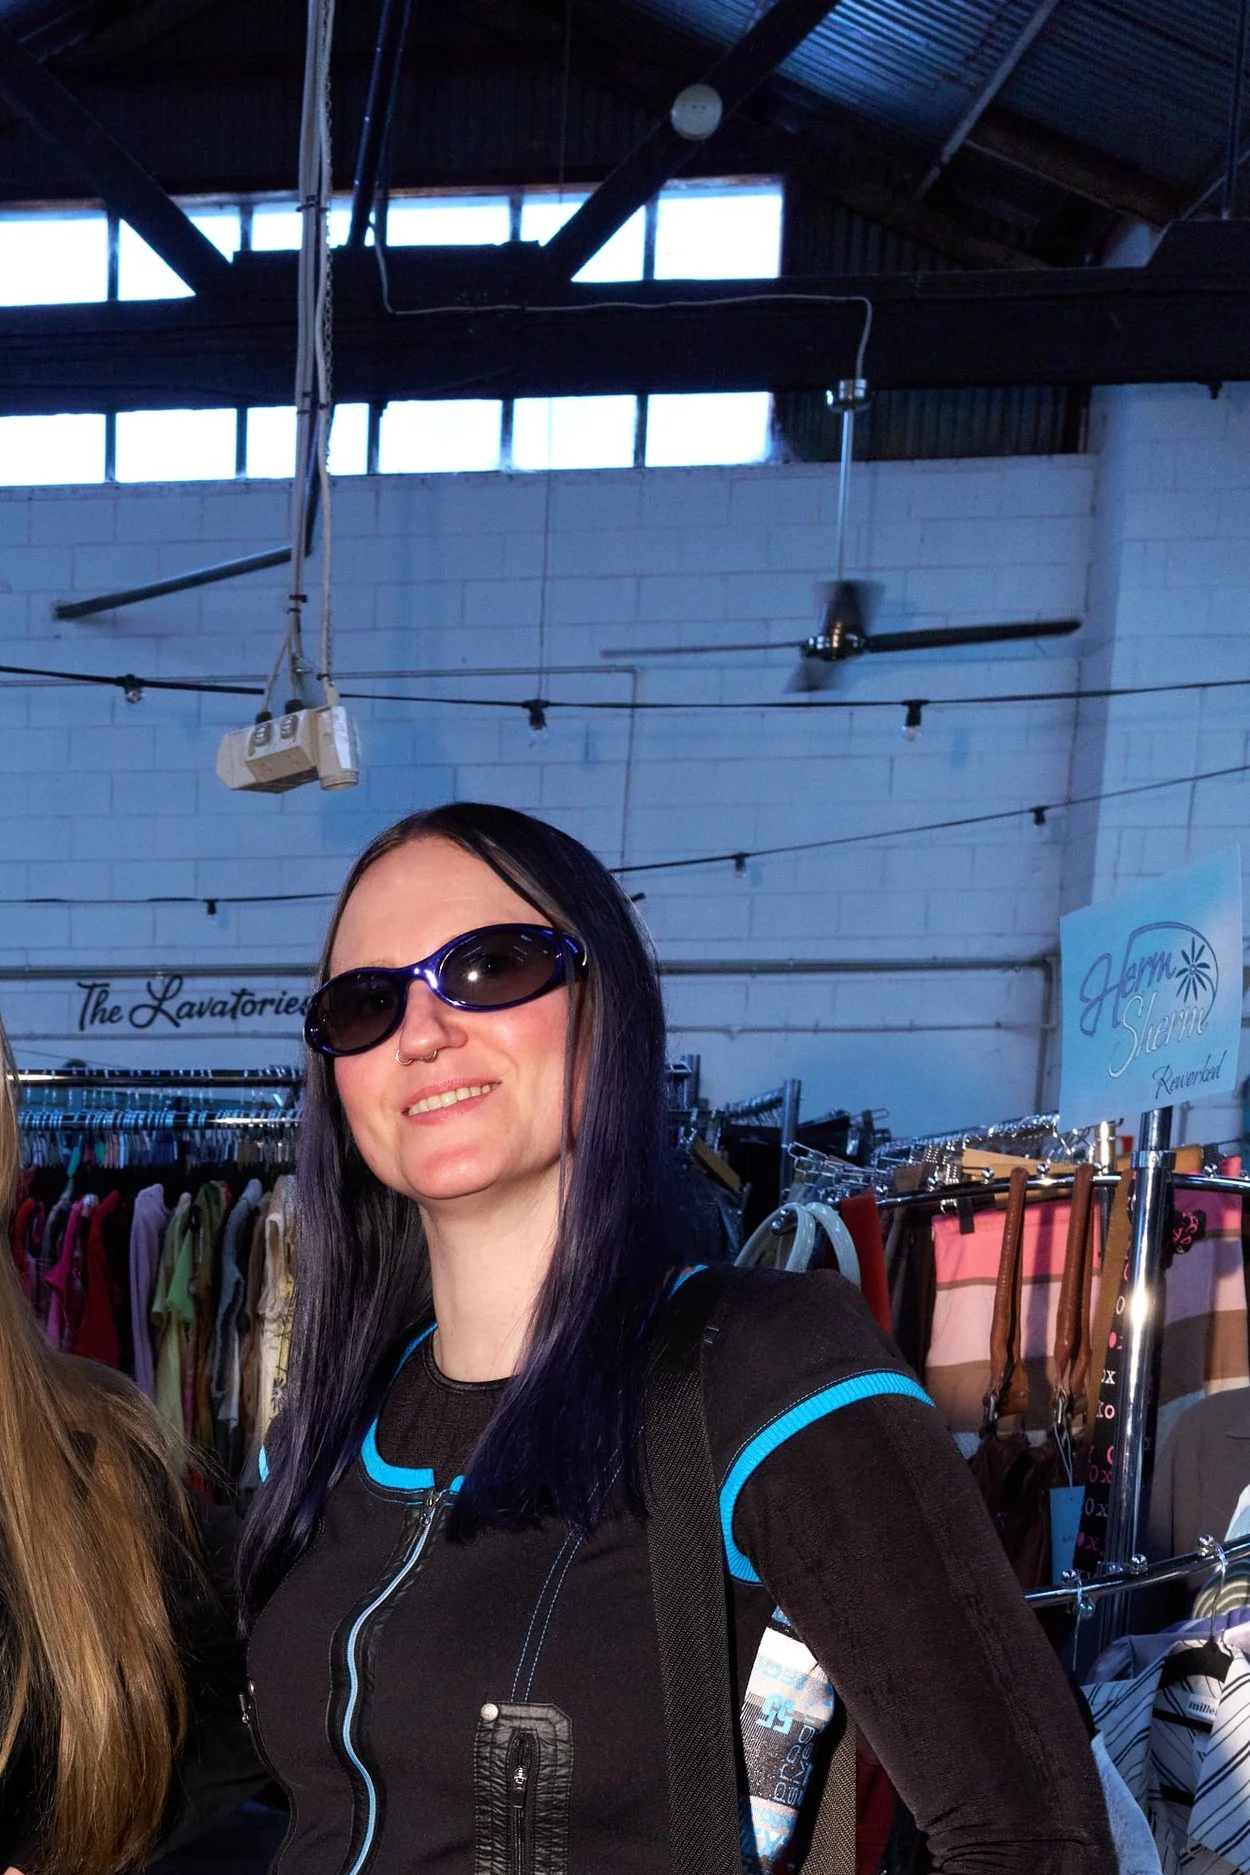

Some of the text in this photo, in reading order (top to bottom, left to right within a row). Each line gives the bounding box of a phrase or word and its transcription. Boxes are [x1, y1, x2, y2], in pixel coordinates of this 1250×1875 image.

[76, 980, 125, 1031] The
[1079, 935, 1177, 1037] Herm
[1107, 991, 1205, 1079] Sherm
[1152, 1050, 1228, 1100] Reworked
[1188, 1701, 1218, 1715] mille
